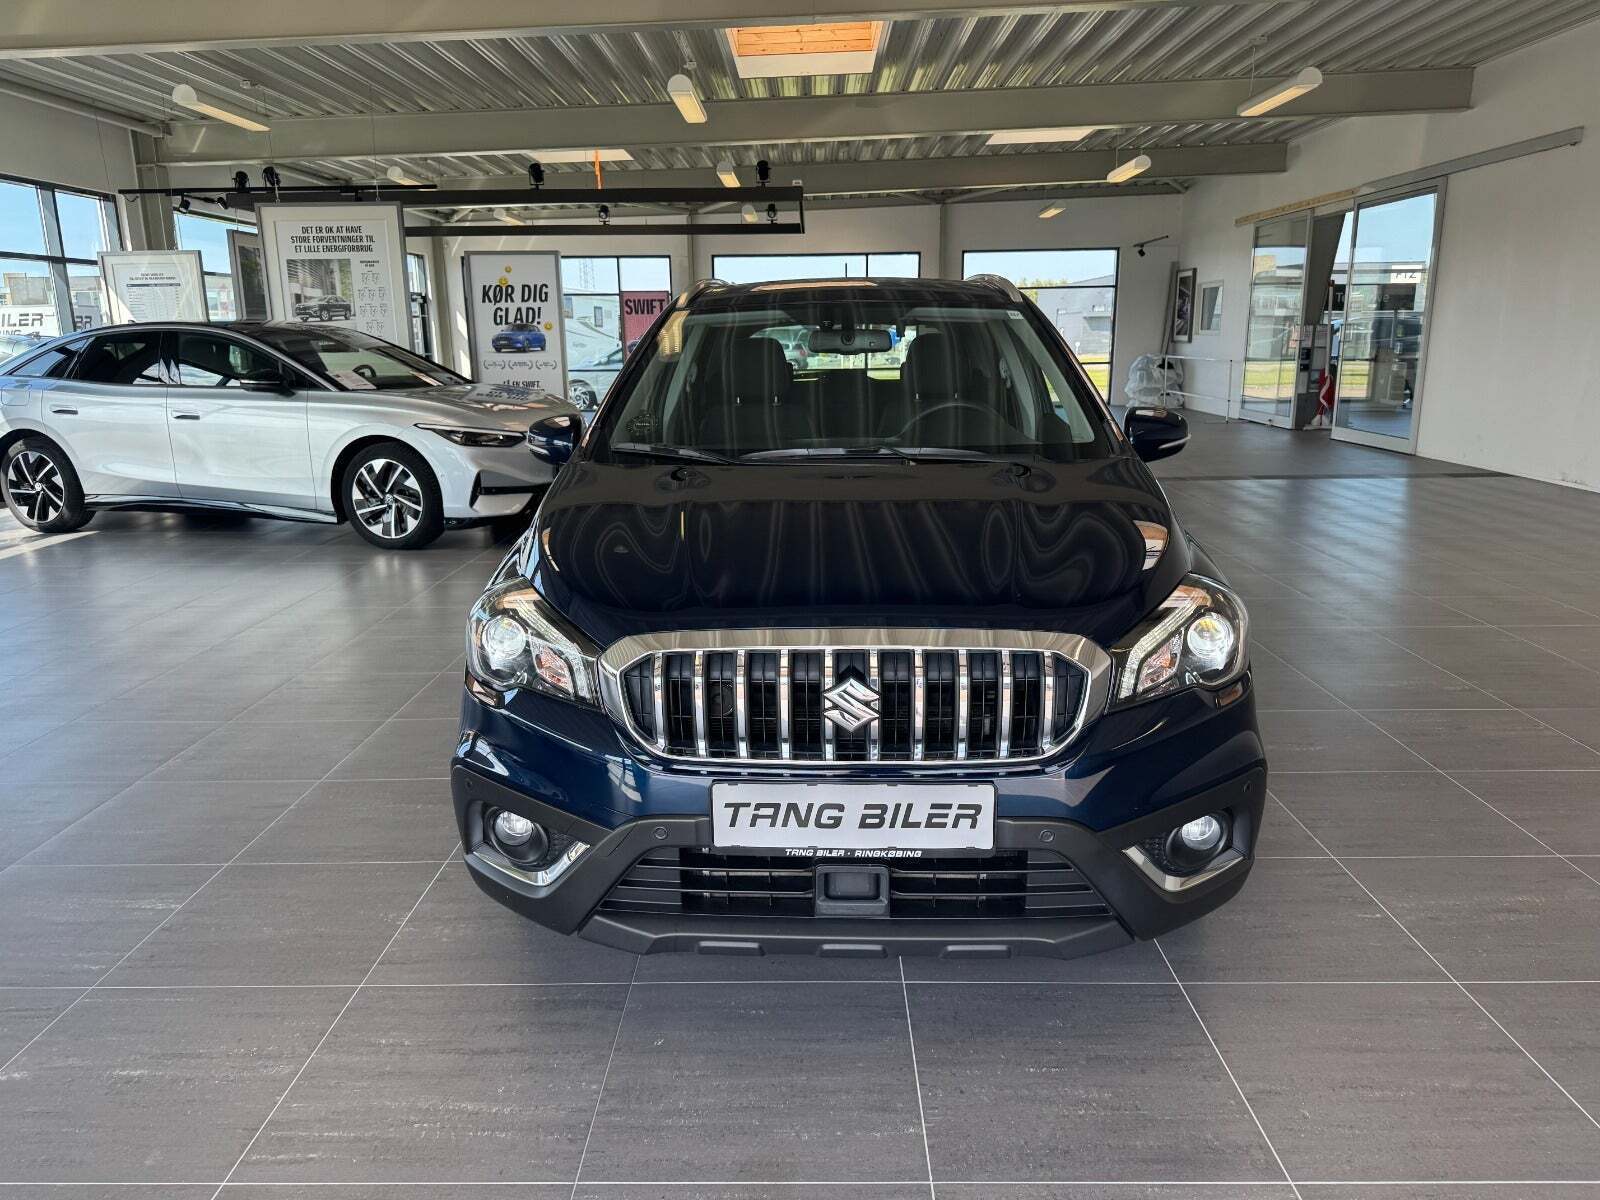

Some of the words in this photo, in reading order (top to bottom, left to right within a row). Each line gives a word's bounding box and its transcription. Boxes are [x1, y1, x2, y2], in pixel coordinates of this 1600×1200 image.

[301, 226, 313, 234] DET
[315, 226, 324, 234] ER
[325, 226, 335, 234] OK
[336, 226, 344, 234] AT
[345, 225, 362, 233] HAVE
[290, 235, 311, 243] STORE
[312, 235, 364, 243] FORVENTNINGER
[365, 235, 375, 243] TIL
[295, 245, 302, 253] ET
[304, 245, 321, 253] LILLE
[322, 244, 374, 253] ENERGIFORBRUG
[481, 284, 515, 305] KØR
[521, 283, 549, 303] DIG
[624, 298, 666, 315] SWIFT
[493, 306, 542, 326] GLAD!
[723, 802, 846, 829] TANG
[857, 802, 983, 830] BILER
[785, 848, 815, 857] TANG
[815, 849, 845, 857] BILER
[854, 849, 922, 858] RINGKØBING
